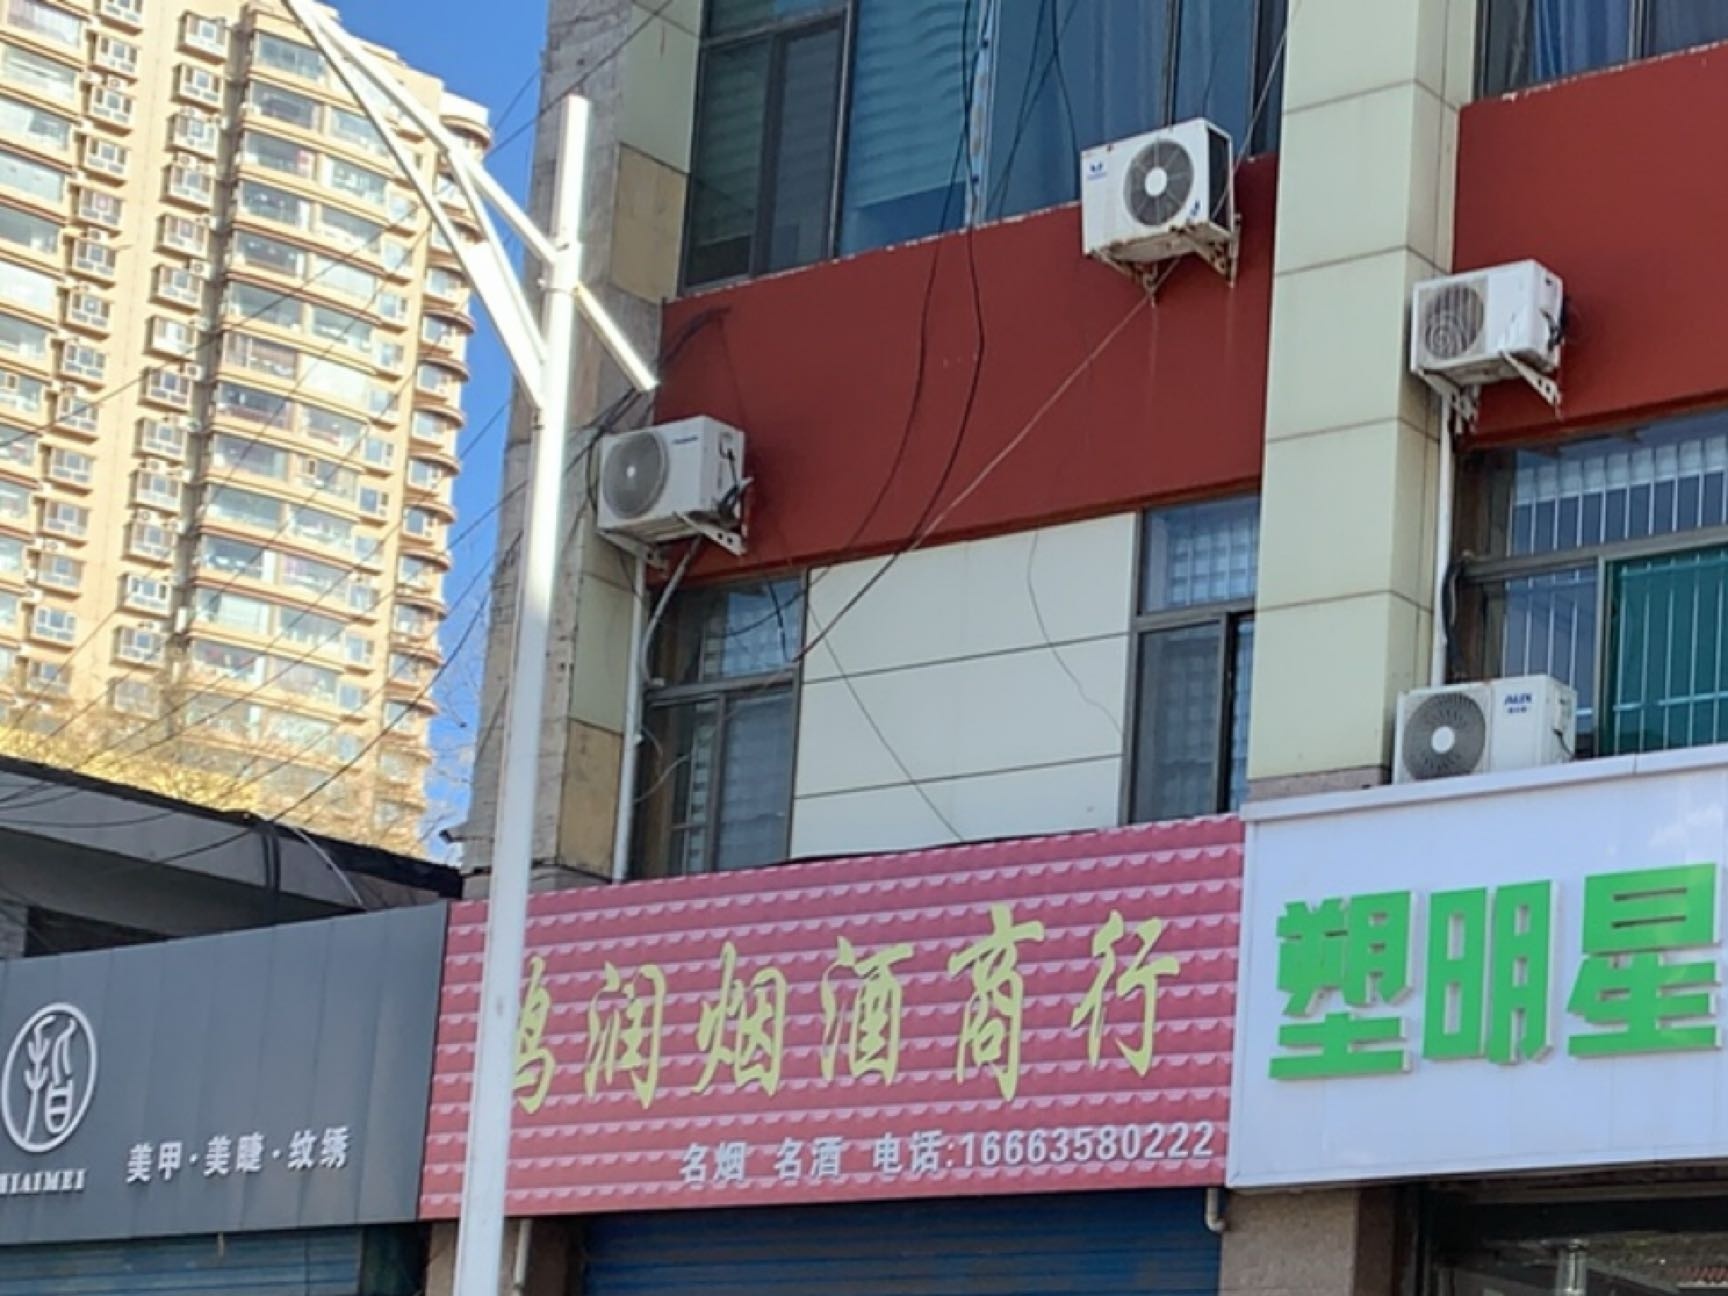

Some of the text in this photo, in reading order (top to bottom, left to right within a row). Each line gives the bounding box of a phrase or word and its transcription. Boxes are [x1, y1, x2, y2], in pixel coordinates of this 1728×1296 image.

[1269, 863, 1721, 1081] 塑明星
[680, 1122, 1214, 1184] 名烟 名酒 电话:16663580222
